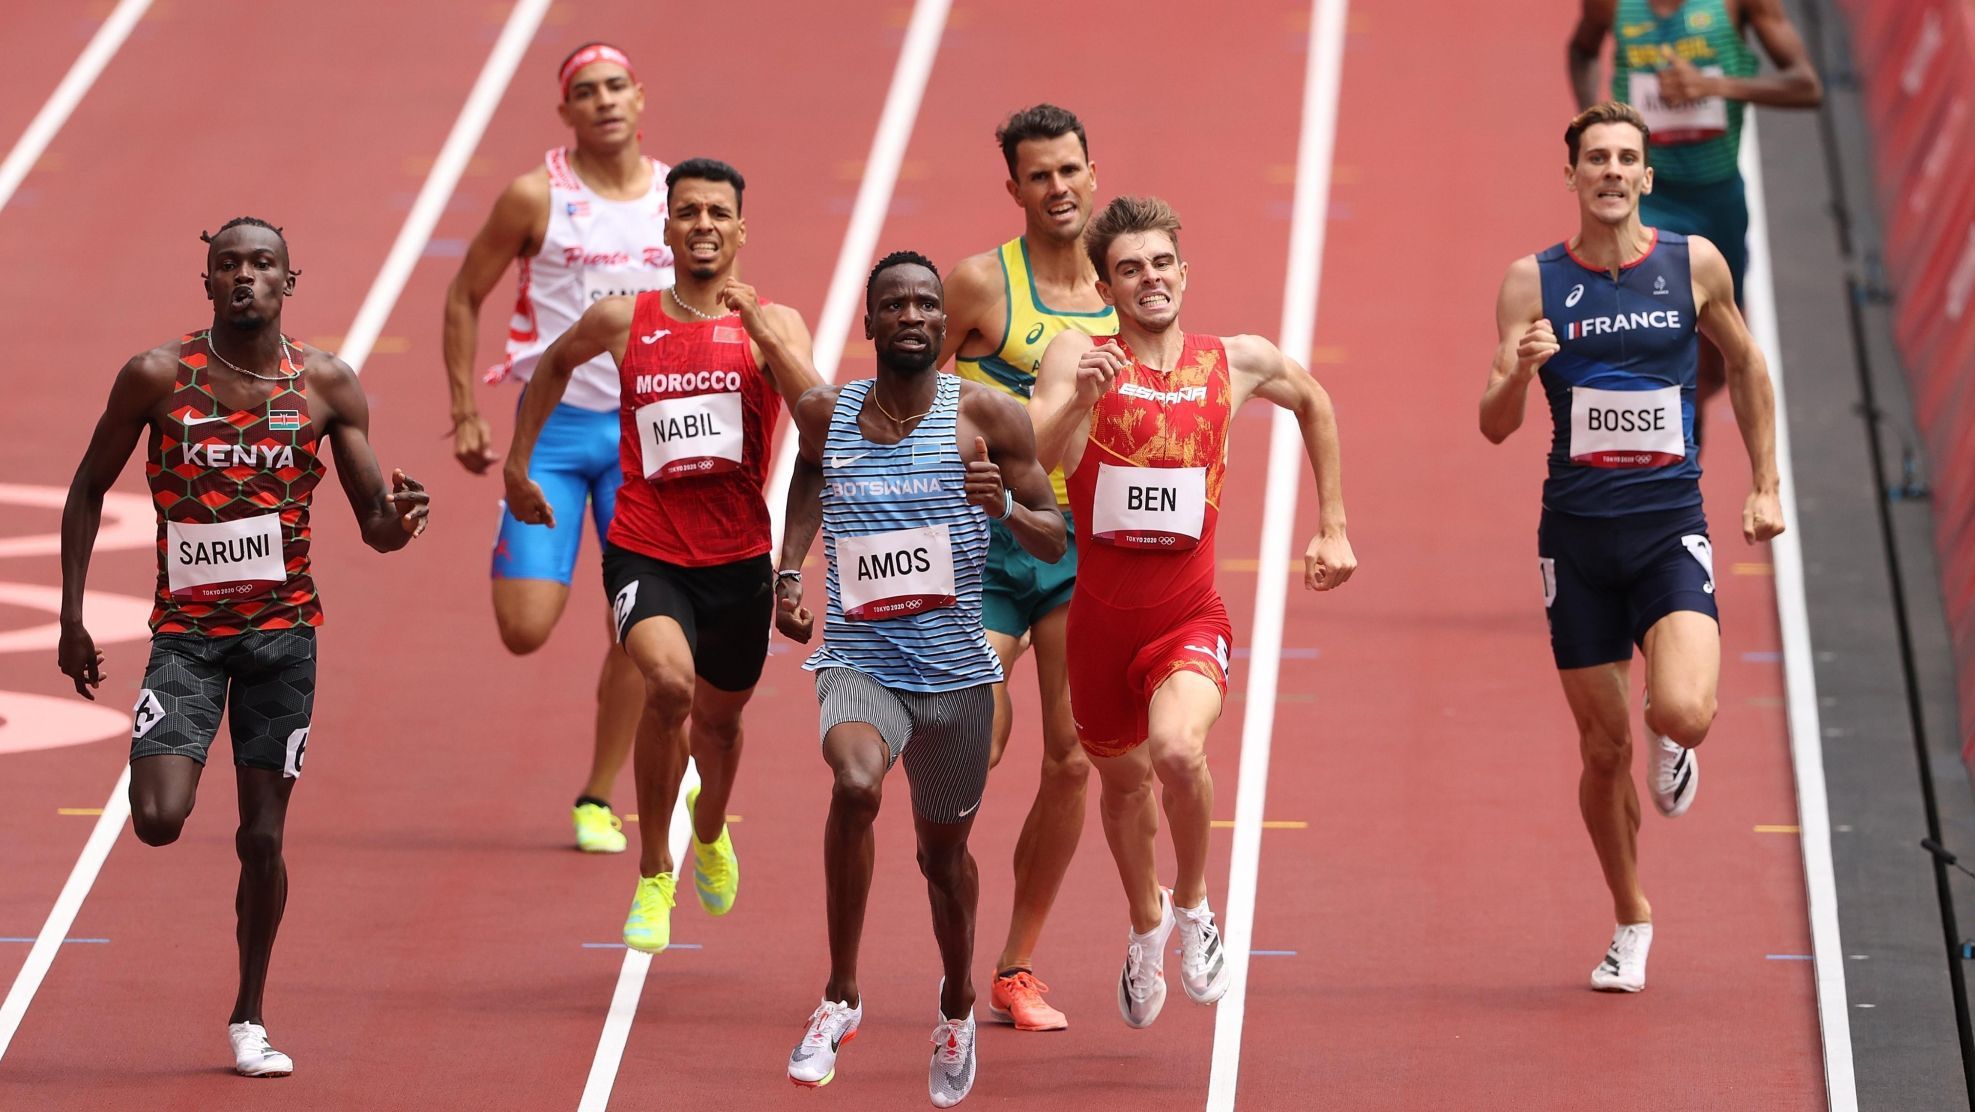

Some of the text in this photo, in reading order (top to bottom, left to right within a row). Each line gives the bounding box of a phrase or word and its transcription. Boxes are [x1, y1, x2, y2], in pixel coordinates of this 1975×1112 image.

[563, 247, 629, 269] Puerto
[1582, 311, 1681, 337] FRANCE
[636, 370, 741, 394] MOROCCO
[1118, 383, 1207, 404] ESPAÑA
[652, 413, 721, 446] NABIL
[1588, 407, 1665, 432] BOSSE
[182, 442, 294, 469] KENYA
[832, 478, 943, 497] BOTSWANA
[1127, 486, 1177, 512] BEN
[179, 533, 270, 566] SARUNI
[1126, 535, 1157, 544] TOKYO 2020
[857, 547, 931, 581] AMOS
[221, 587, 235, 595] 2020
[873, 603, 905, 613] TOKYO 2020
